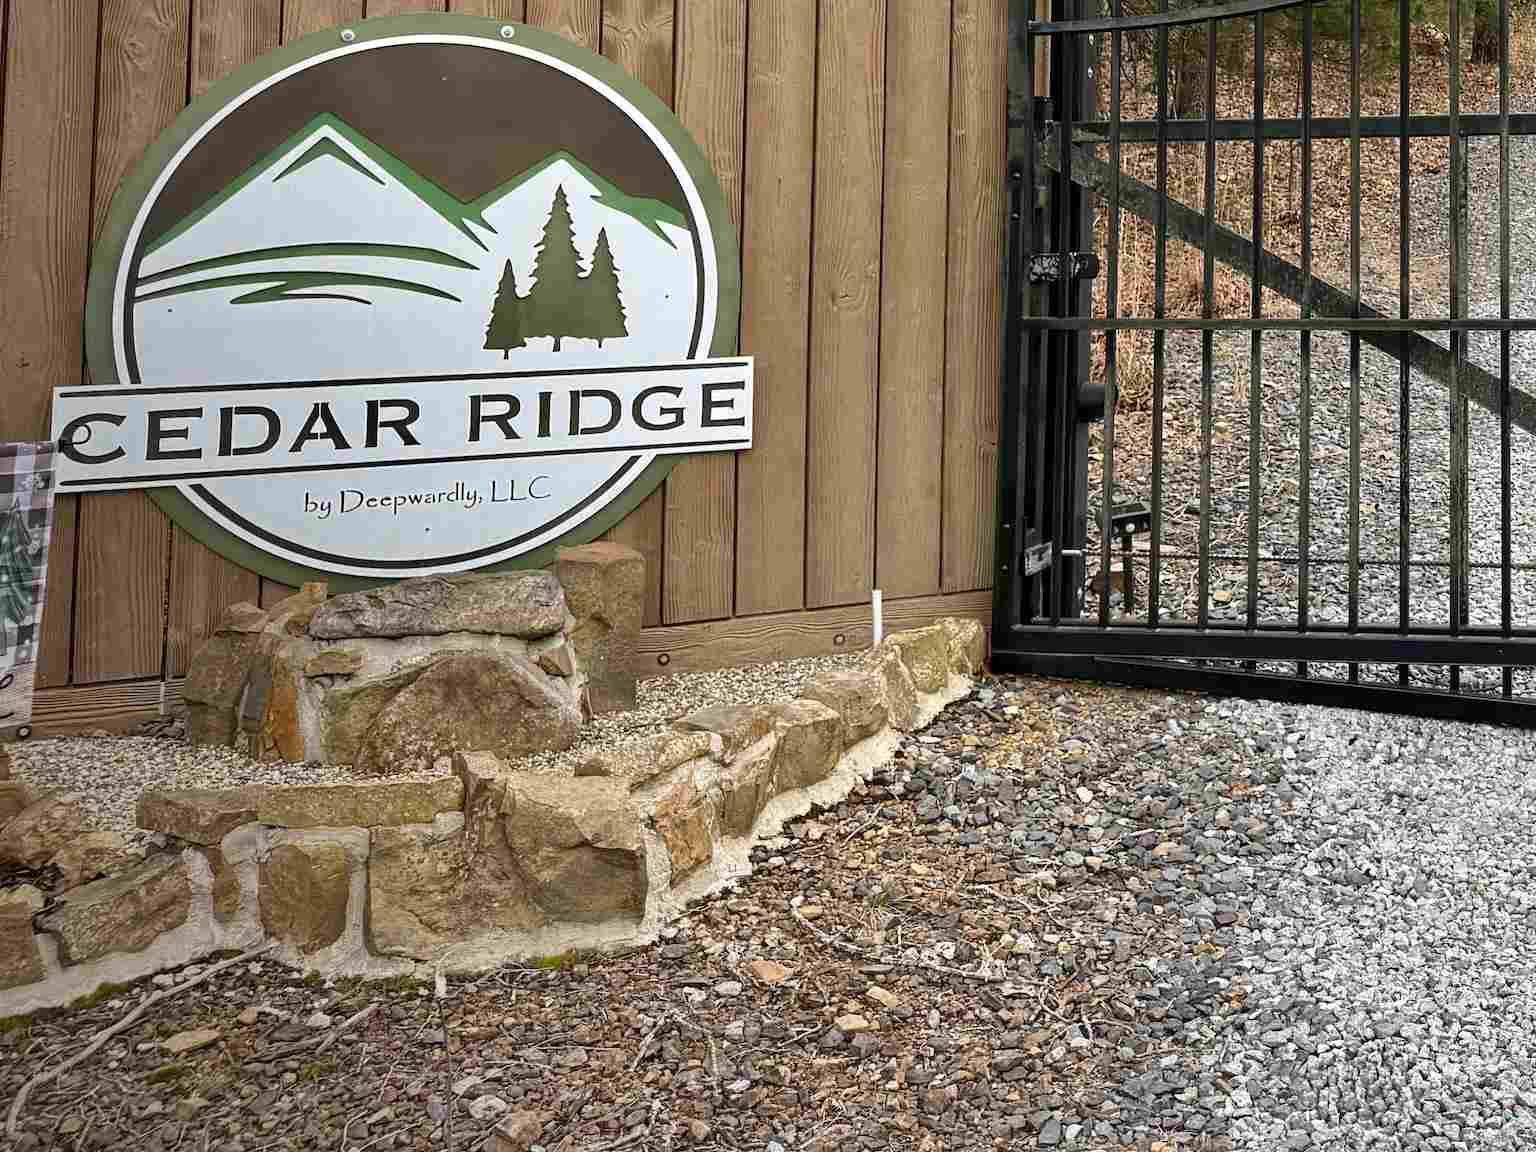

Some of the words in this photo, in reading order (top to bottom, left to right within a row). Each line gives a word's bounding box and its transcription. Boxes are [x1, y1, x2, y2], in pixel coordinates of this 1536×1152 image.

[62, 398, 422, 464] CEDAR
[467, 380, 746, 442] RIDGE
[303, 491, 332, 520] by
[340, 480, 483, 516] Deepwardly,
[490, 474, 552, 504] LLC
